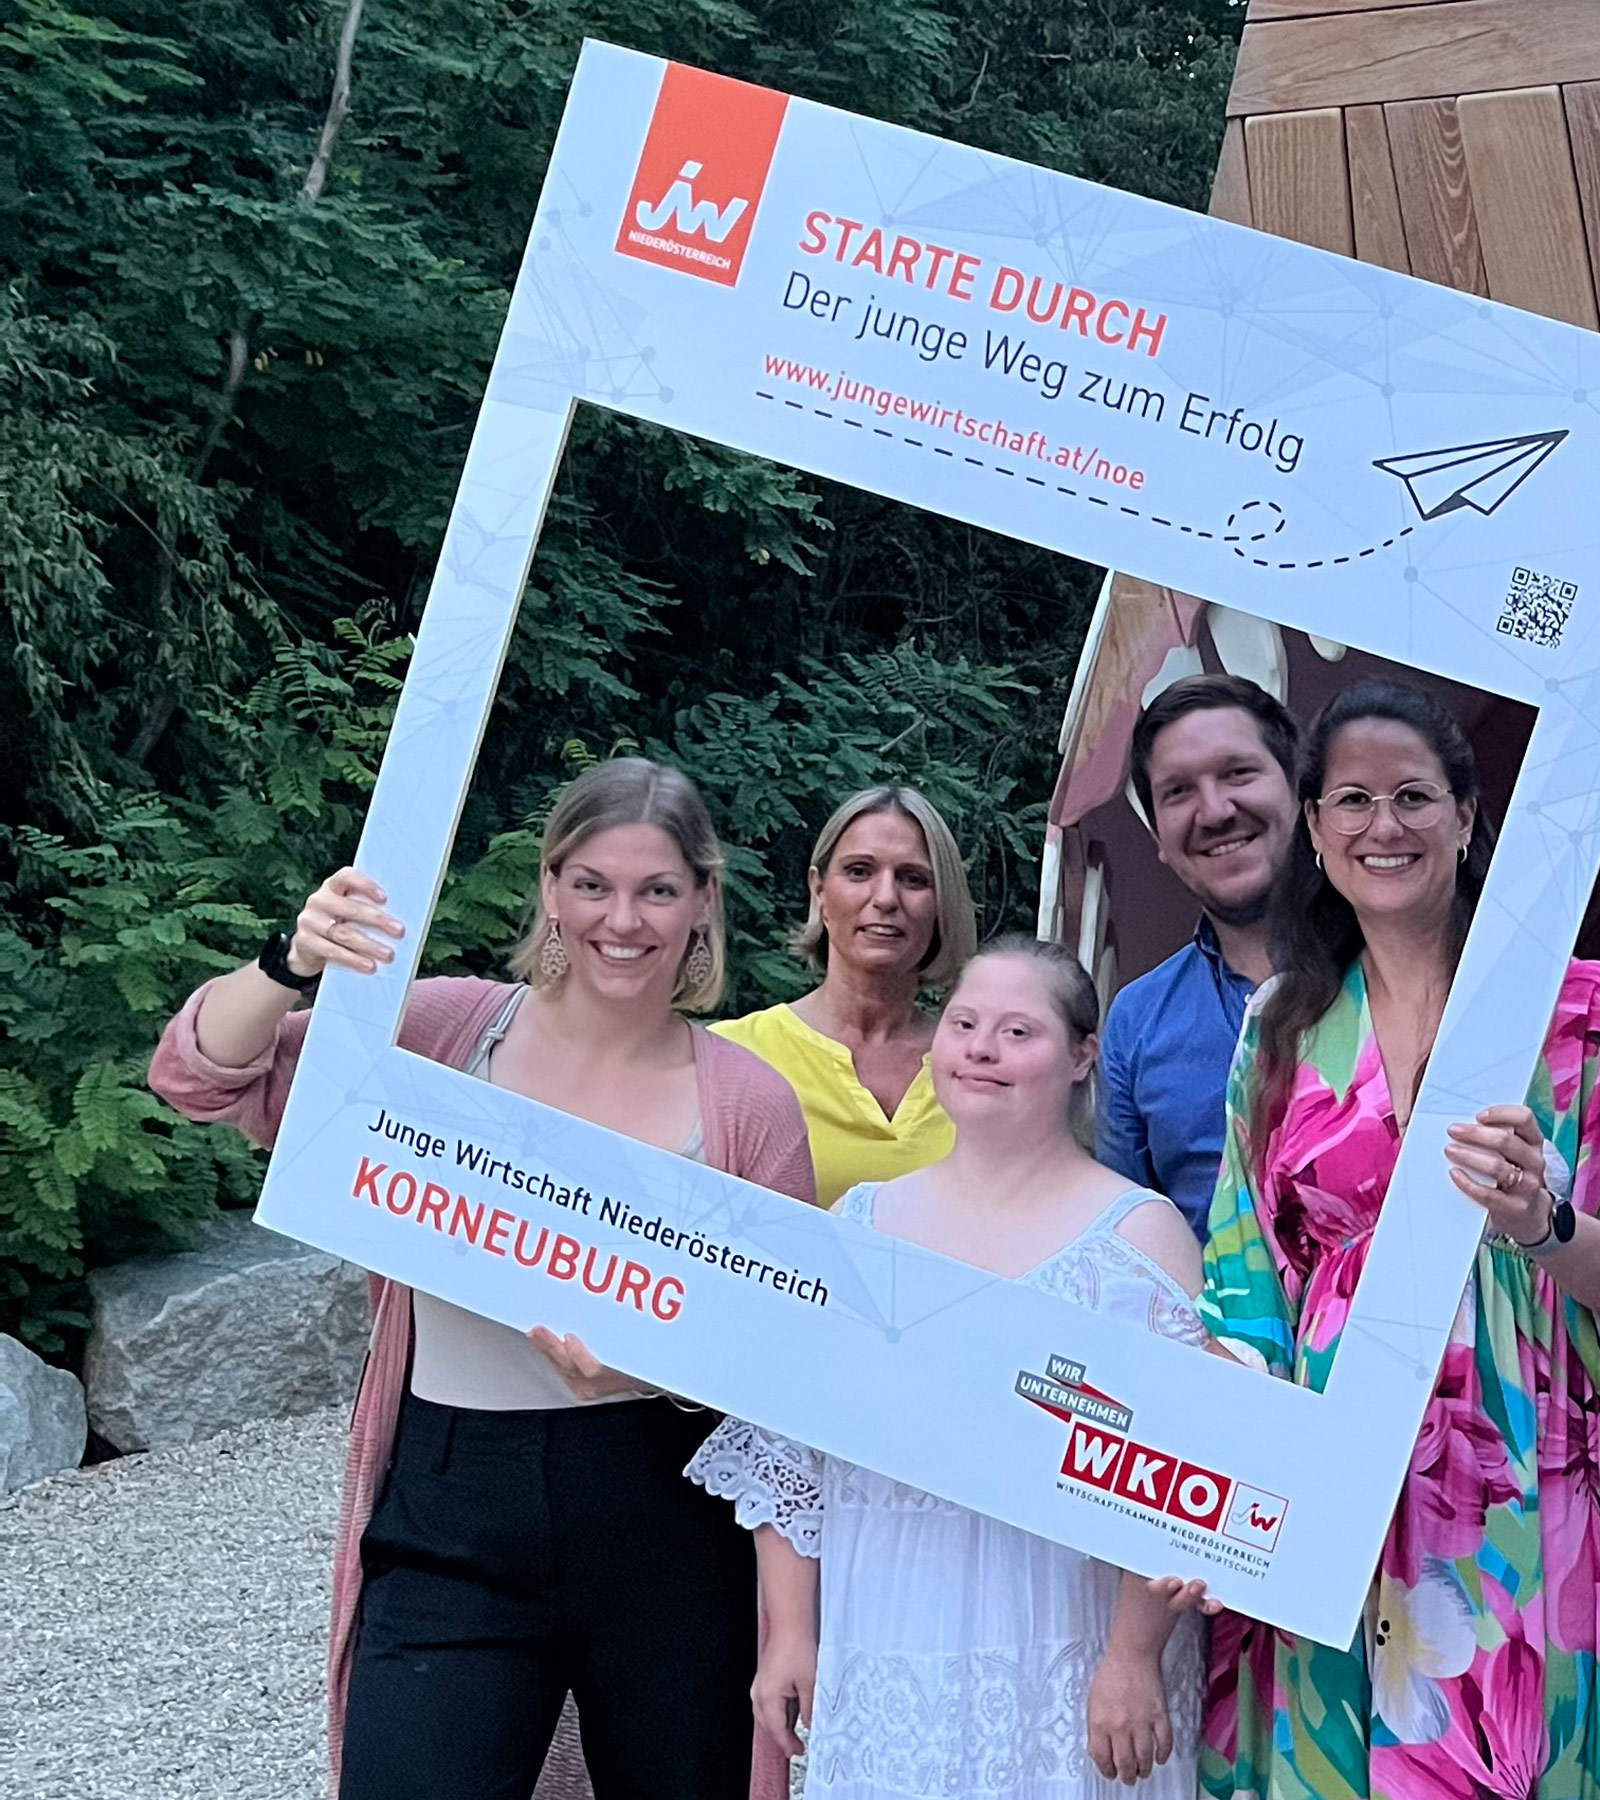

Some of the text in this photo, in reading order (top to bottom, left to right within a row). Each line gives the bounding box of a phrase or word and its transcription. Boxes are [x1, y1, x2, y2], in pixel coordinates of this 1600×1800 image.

[628, 229, 731, 270] NIEDERÖSTERREICH
[799, 211, 1168, 357] STARTE DURCH
[782, 270, 1304, 473] Der junge Weg zum Erfolg
[764, 353, 1145, 490] www.jungewirtschaft.at/noe
[351, 1156, 685, 1321] KORNEUBURG
[368, 1109, 829, 1306] Junge Wirtschaft Niederösterreich
[1020, 1376, 1129, 1427] UNTERNEHMEN
[1050, 1359, 1083, 1381] WIR
[1073, 1428, 1220, 1517] WKO
[1056, 1481, 1271, 1568] WIRTSCHAFTSKAMMER NIEDERÖSTERREICH
[1169, 1538, 1267, 1580] JUNGE WIRTSCHAFT
